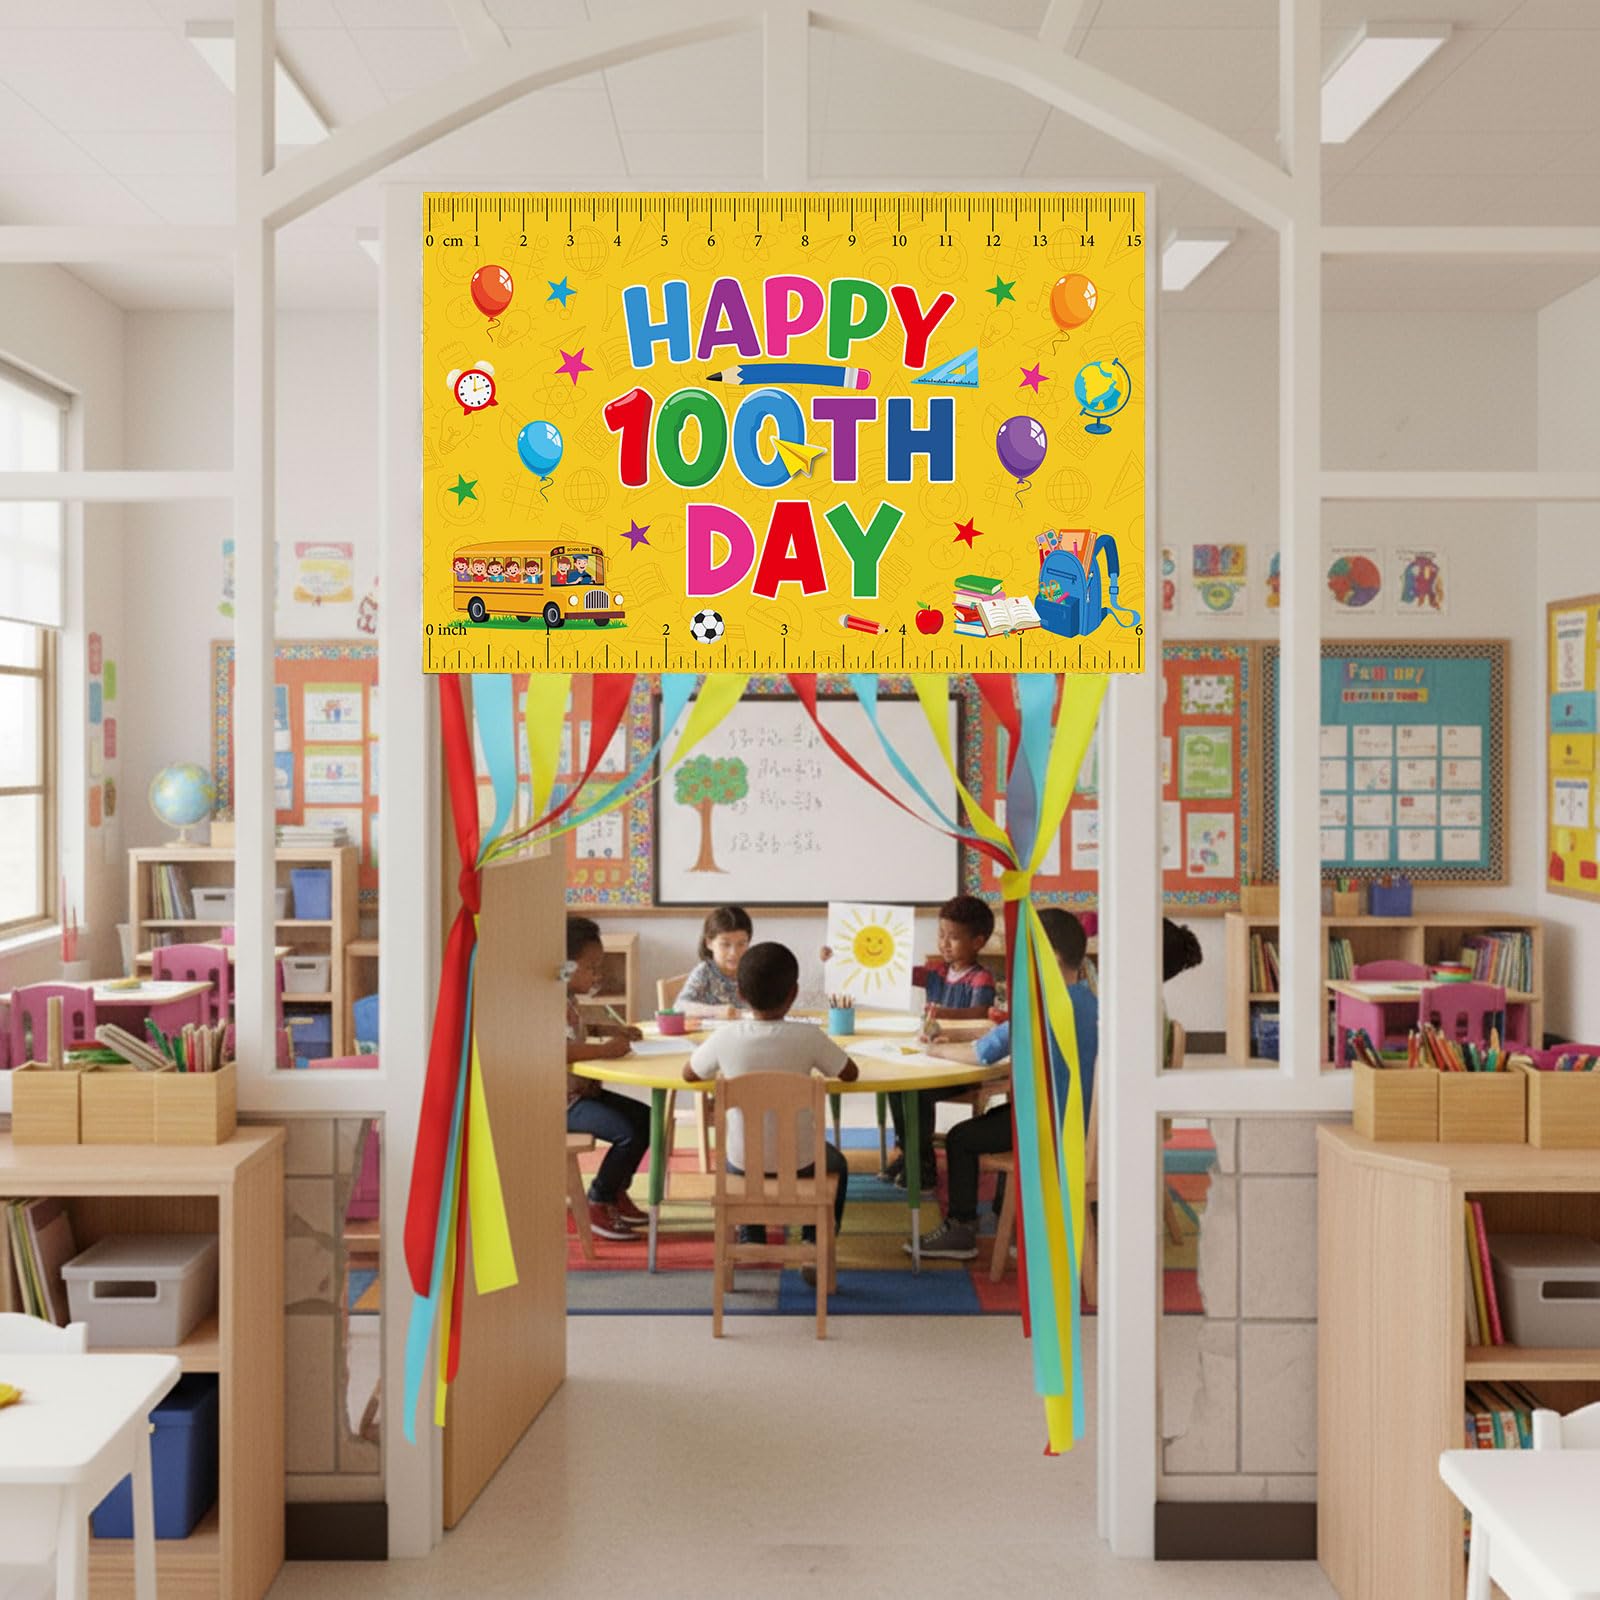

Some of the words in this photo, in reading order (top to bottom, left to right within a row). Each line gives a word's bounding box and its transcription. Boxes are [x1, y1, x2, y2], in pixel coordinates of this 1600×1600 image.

[425, 234, 434, 247] 0
[442, 237, 463, 247] cm
[474, 234, 480, 247] 1
[519, 234, 528, 247] 2
[566, 234, 575, 247] 3
[613, 234, 622, 247] 4
[660, 234, 669, 247] 5
[707, 234, 716, 247] 6
[754, 234, 763, 247] 7
[801, 234, 810, 247] 8
[848, 234, 857, 247] 9
[892, 234, 908, 247] 10
[940, 234, 953, 247] 11
[986, 234, 1001, 247] 12
[1033, 234, 1048, 247] 13
[1080, 234, 1095, 247] 14
[1127, 234, 1143, 247] 15
[622, 275, 955, 370] HAPPY
[603, 387, 955, 488] 100TH
[686, 501, 905, 600] DAY
[425, 623, 434, 636] 0
[438, 621, 467, 636] inch
[662, 623, 671, 636] 2
[780, 623, 789, 636] 3
[898, 623, 907, 636] 4
[1135, 623, 1144, 636] 6
